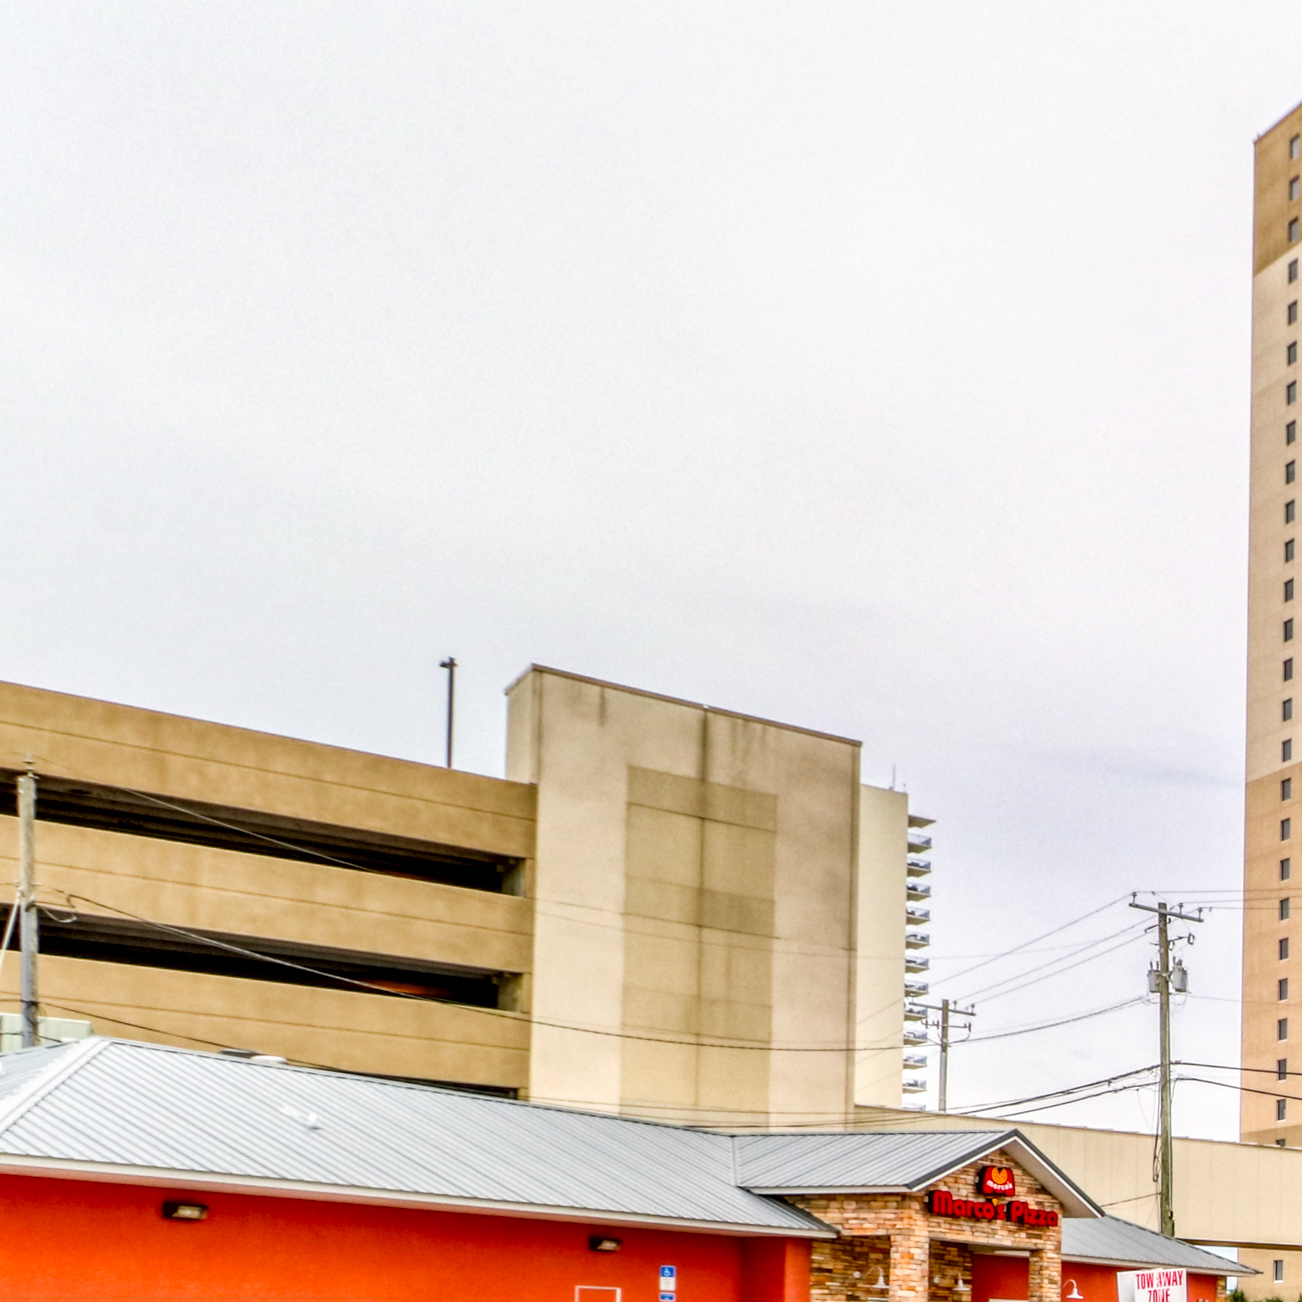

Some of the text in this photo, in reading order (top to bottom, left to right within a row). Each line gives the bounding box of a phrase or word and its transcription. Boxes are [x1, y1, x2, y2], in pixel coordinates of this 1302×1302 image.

[1009, 1200, 1058, 1227] Pizza
[1136, 1271, 1183, 1289] TOW AWAY
